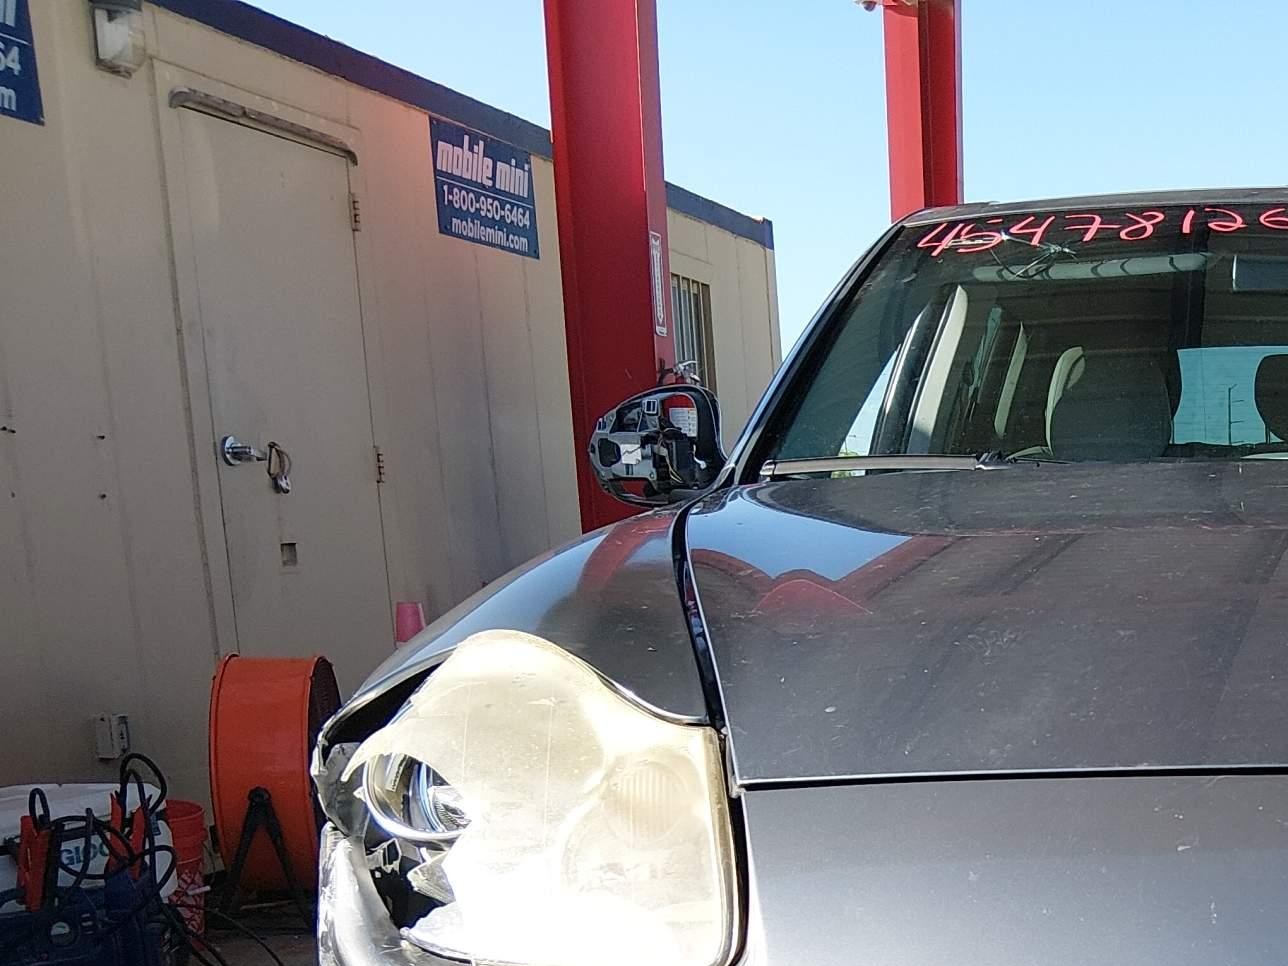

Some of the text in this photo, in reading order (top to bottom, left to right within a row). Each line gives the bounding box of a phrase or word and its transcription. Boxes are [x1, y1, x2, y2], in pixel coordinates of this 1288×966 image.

[437, 134, 529, 198] mobile mini
[443, 184, 530, 229] 1-800-950-6464
[452, 217, 529, 253] mobilemini.com
